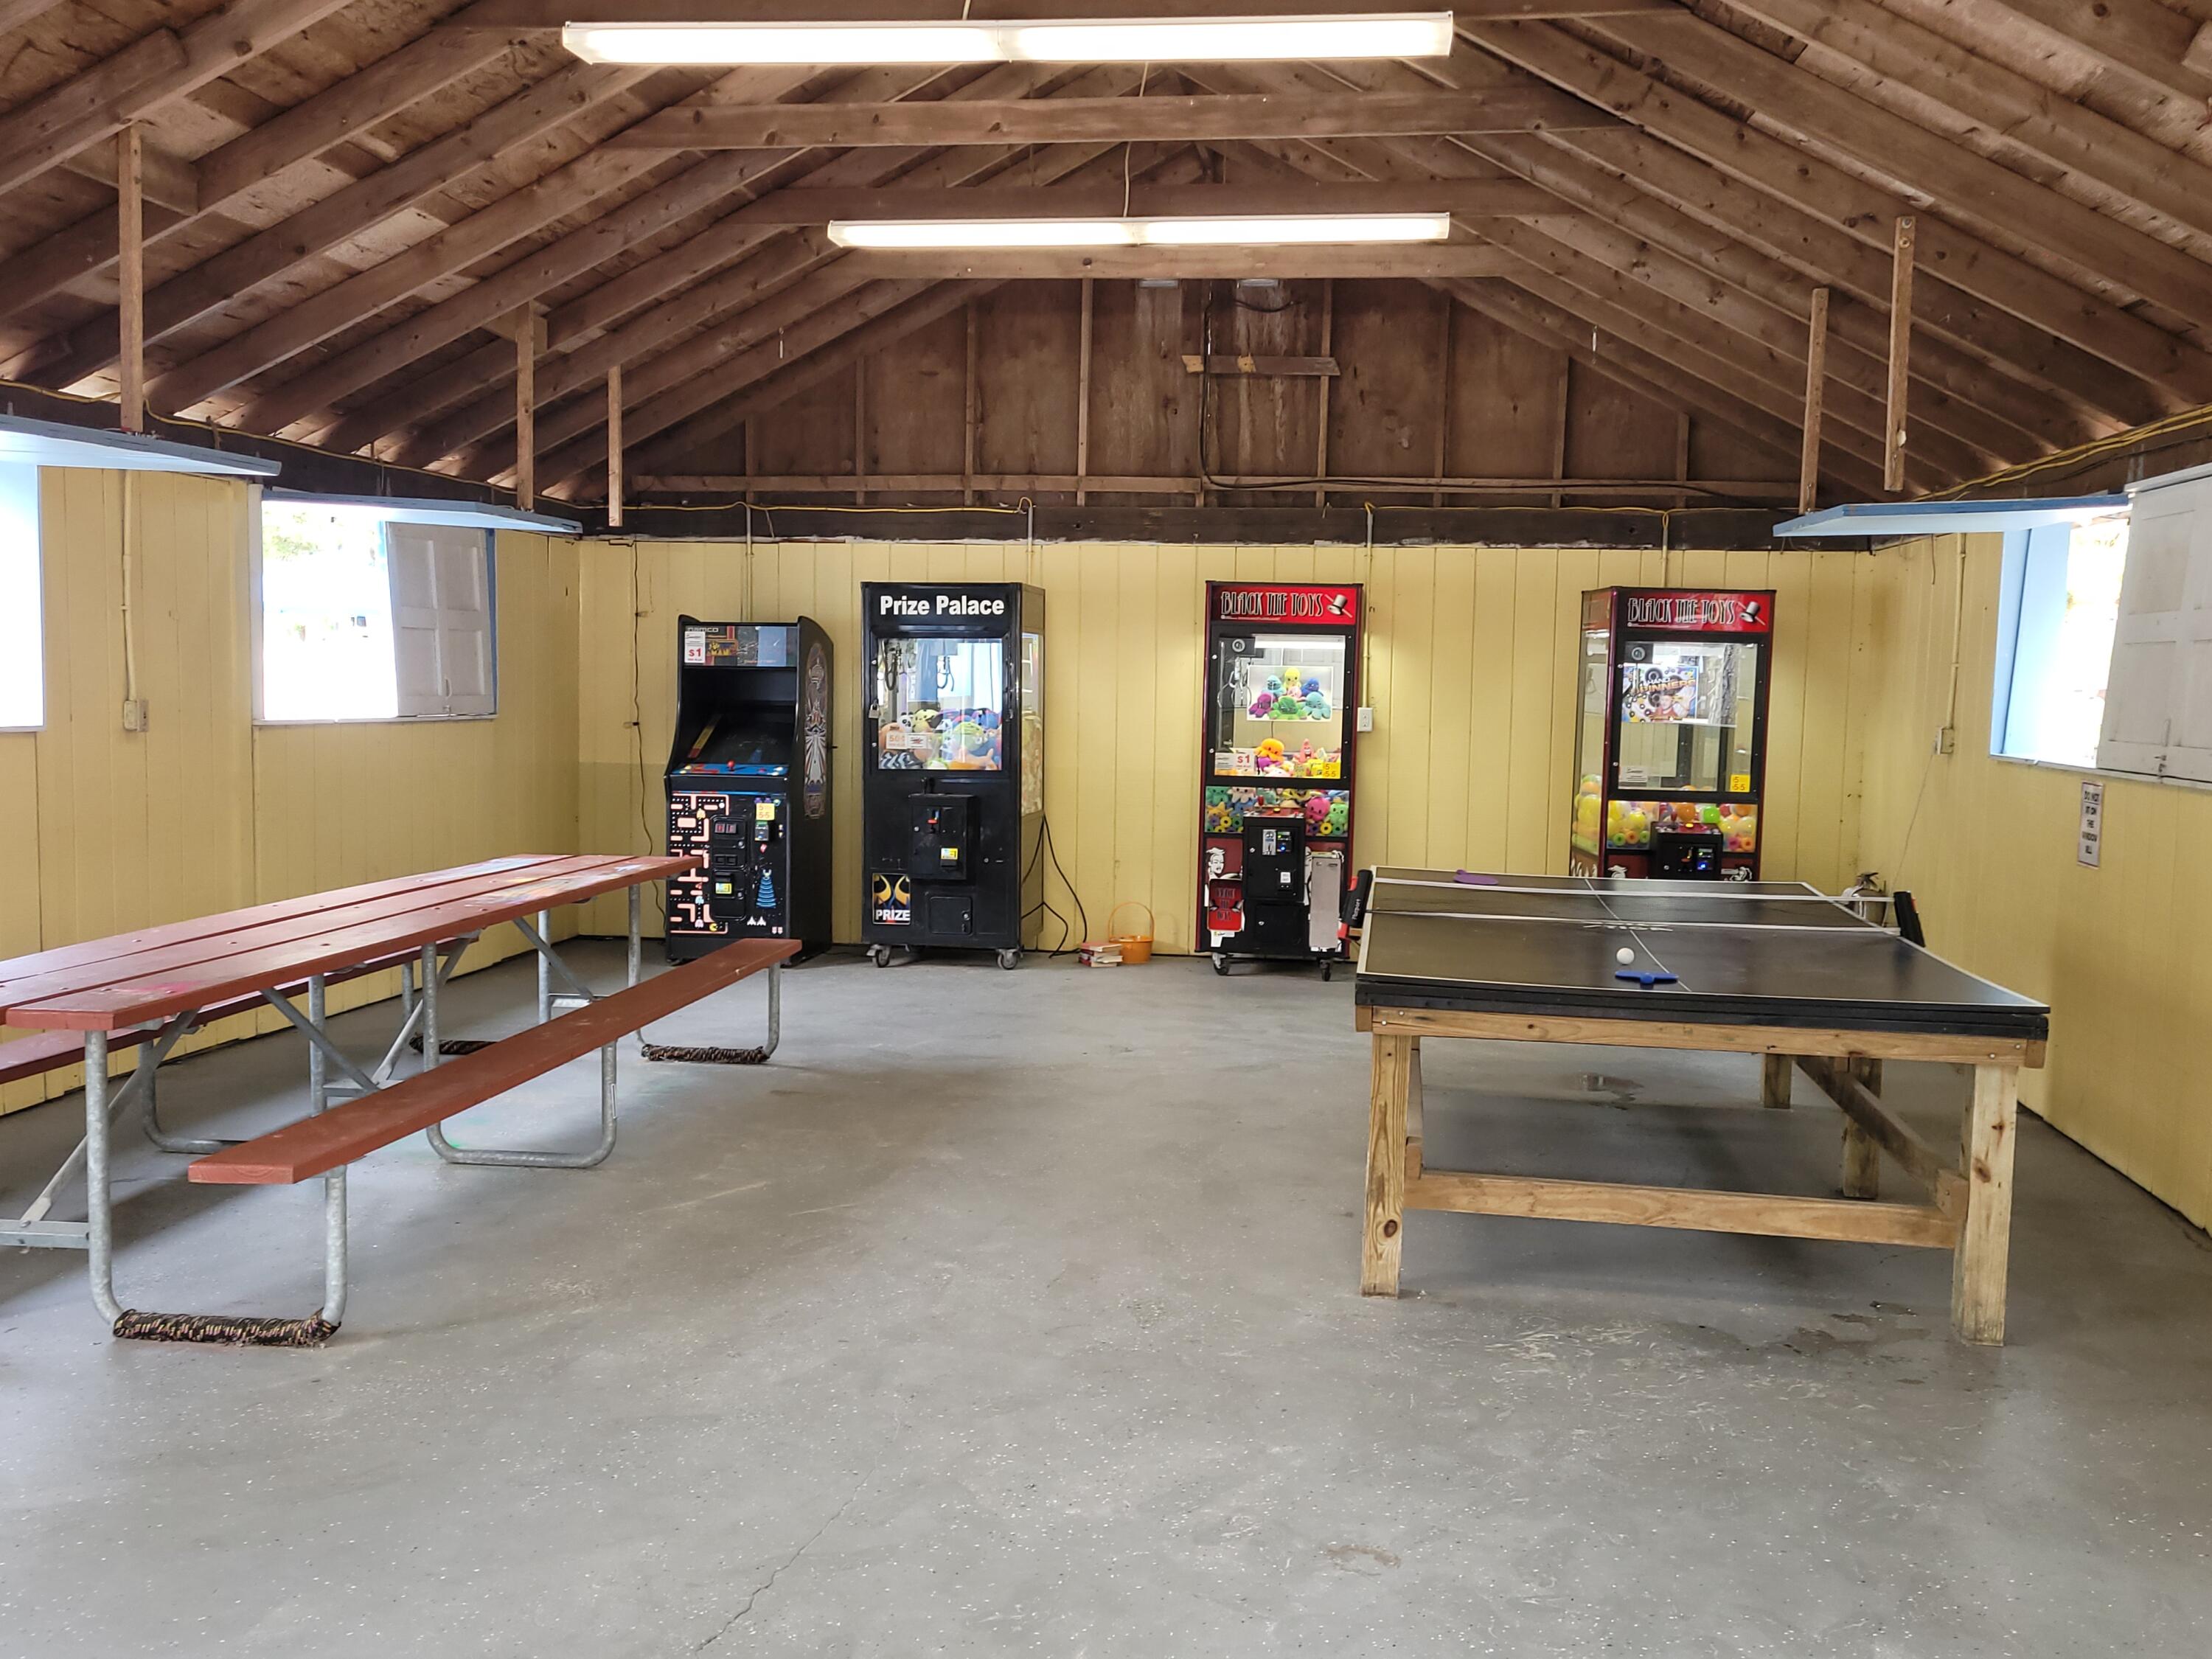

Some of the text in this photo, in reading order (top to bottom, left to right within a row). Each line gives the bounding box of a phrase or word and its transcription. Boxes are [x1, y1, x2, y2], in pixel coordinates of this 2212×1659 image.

[880, 595, 1004, 615] Prize Palace
[1220, 591, 1324, 617] BLACK TIE TOYS
[1627, 597, 1673, 622] BLACK
[1701, 599, 1735, 625] TOYS
[875, 909, 911, 921] PRIZE
